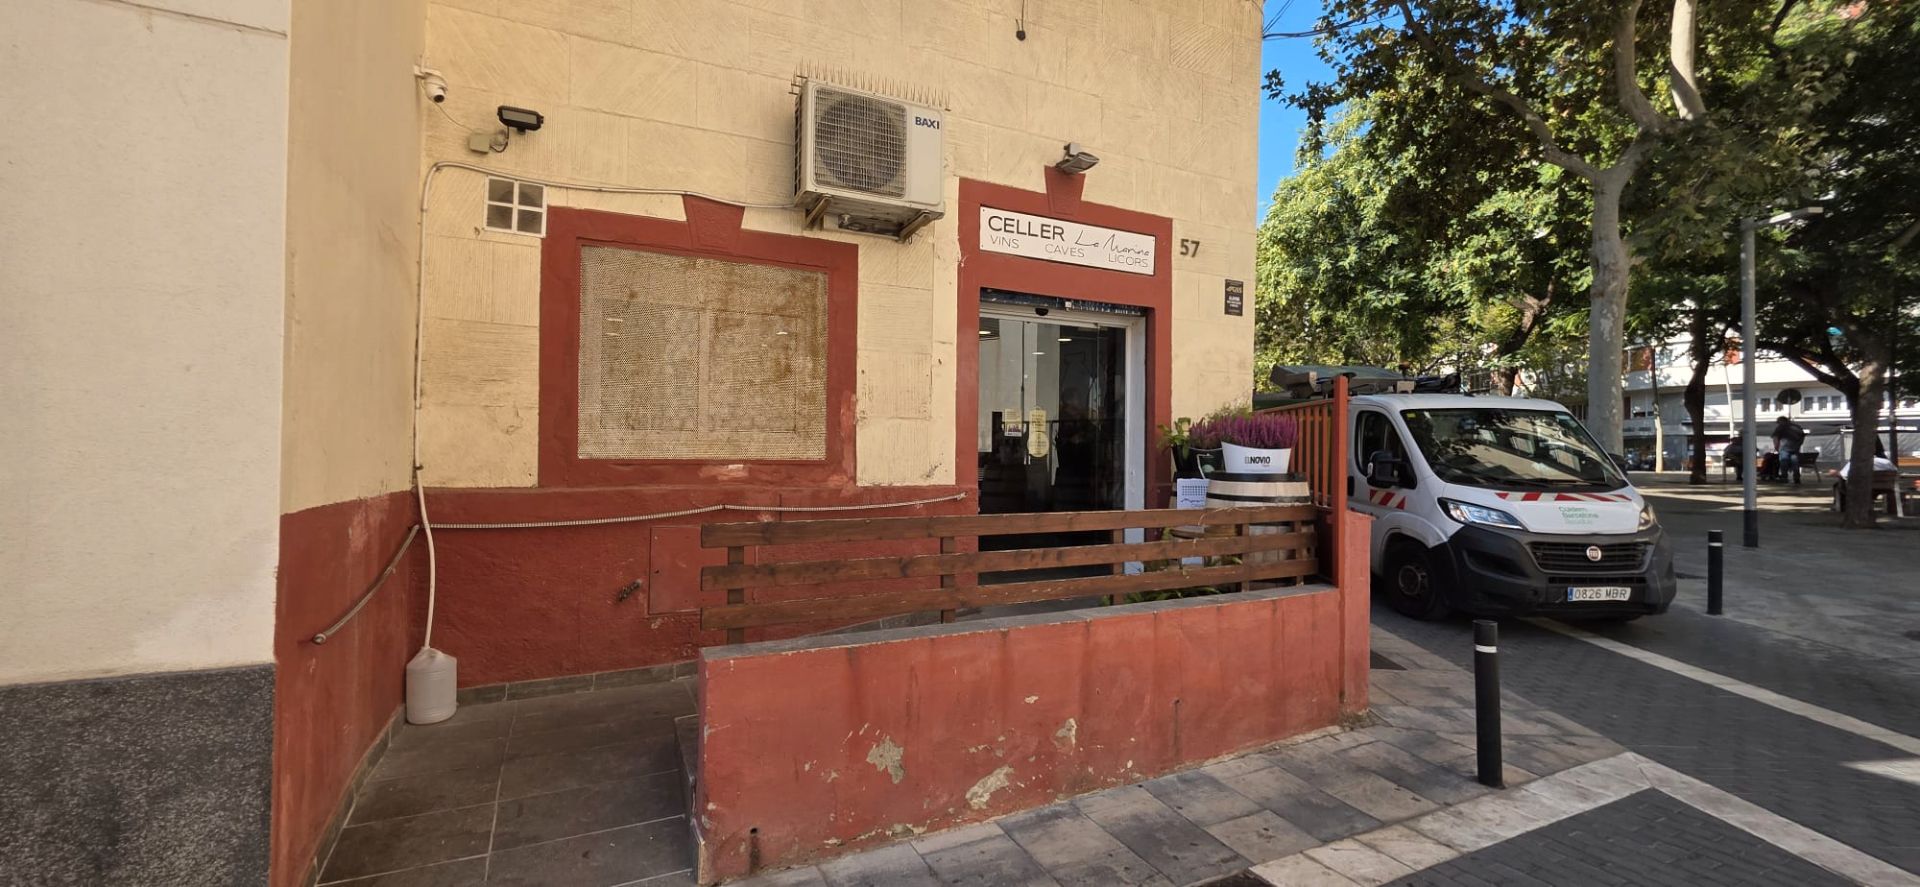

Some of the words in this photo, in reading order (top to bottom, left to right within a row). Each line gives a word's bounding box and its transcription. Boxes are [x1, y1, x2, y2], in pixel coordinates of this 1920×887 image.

[915, 117, 940, 130] BAXI
[988, 215, 1065, 241] CELLER
[1074, 229, 1099, 247] La
[990, 235, 1019, 249] VINS
[1045, 243, 1085, 258] CAVES
[1108, 253, 1149, 268] LICORS
[1180, 238, 1200, 258] 57
[1573, 588, 1602, 599] 0826
[1605, 588, 1627, 599] MBR
